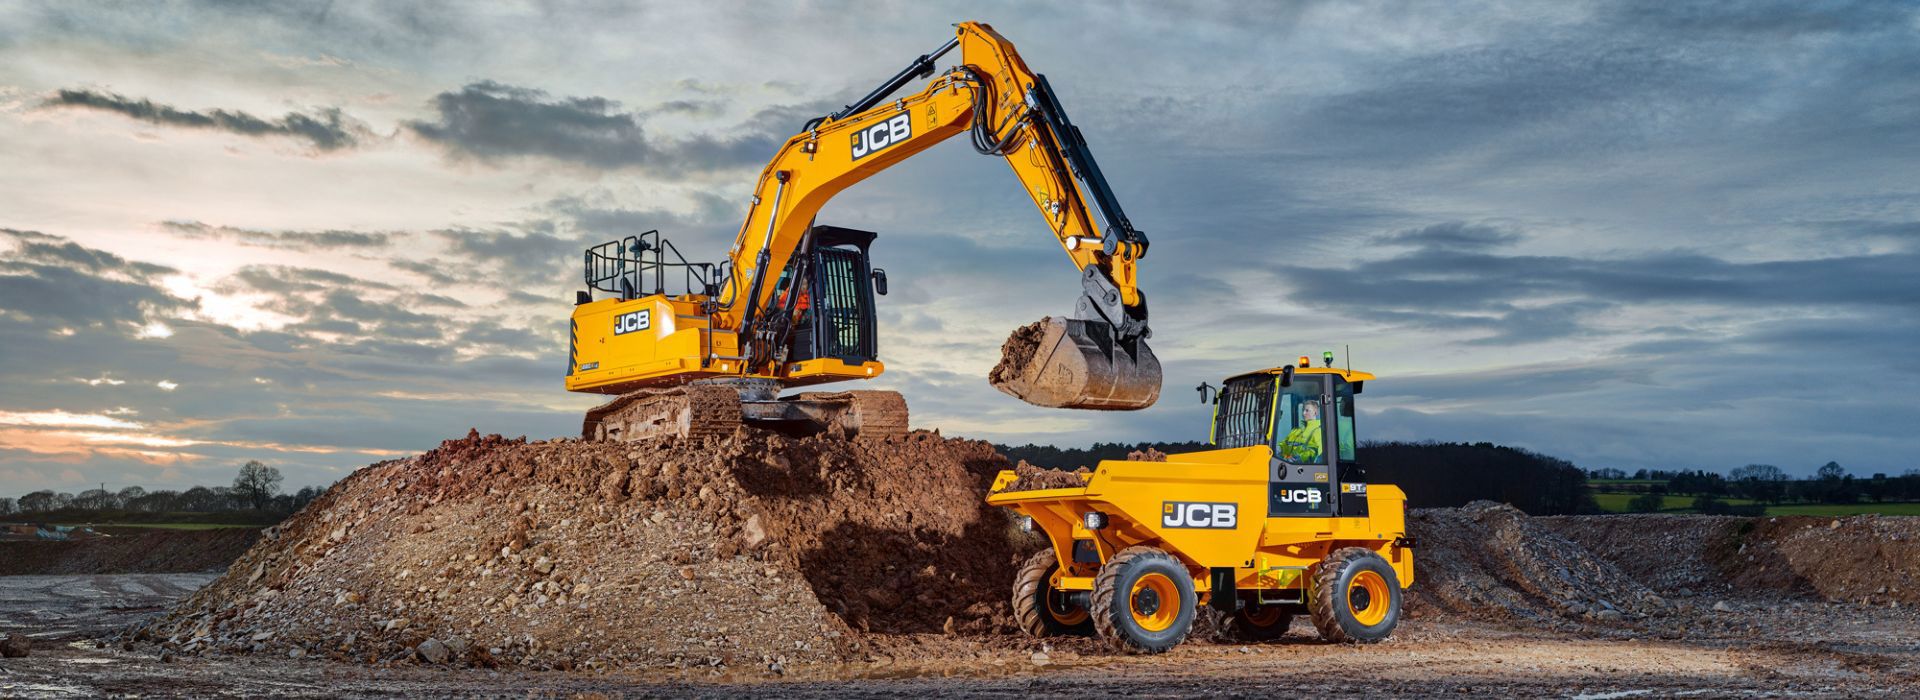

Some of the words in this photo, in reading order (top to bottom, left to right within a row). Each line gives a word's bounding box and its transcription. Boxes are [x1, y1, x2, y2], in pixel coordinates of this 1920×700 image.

[852, 113, 910, 158] JCB
[615, 310, 649, 334] JCB
[1281, 489, 1322, 503] JCB
[1164, 503, 1236, 528] JCB
